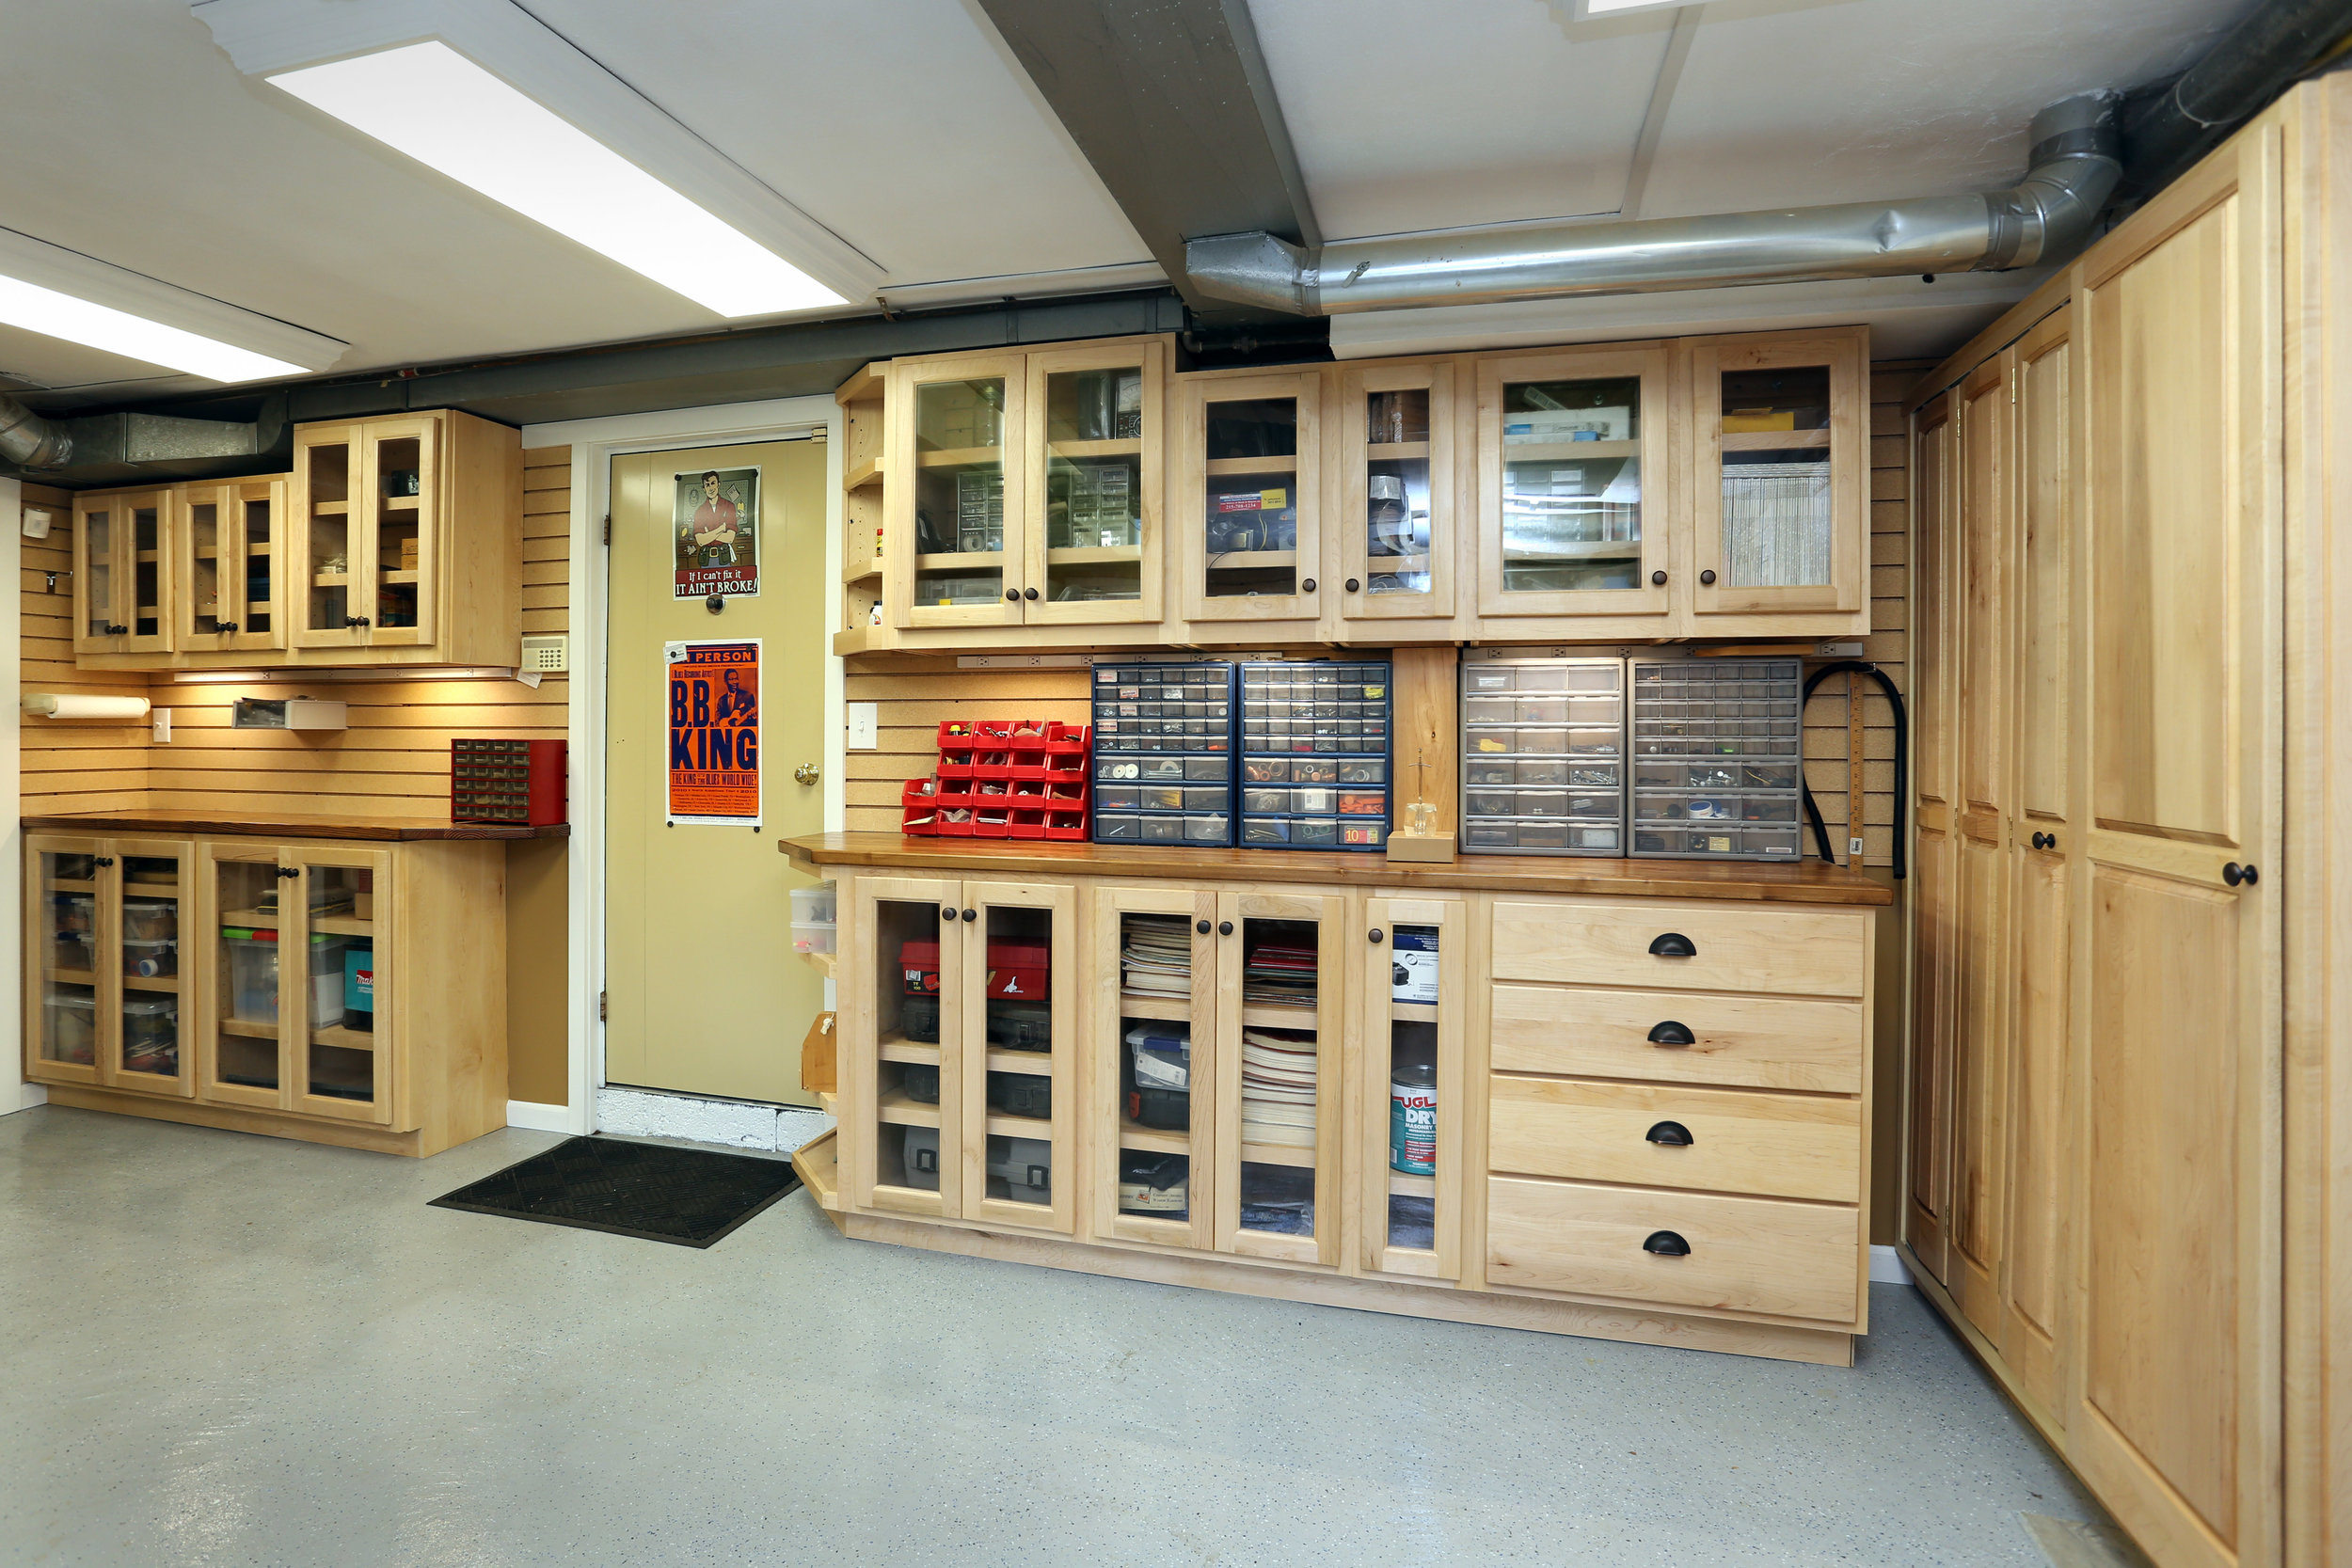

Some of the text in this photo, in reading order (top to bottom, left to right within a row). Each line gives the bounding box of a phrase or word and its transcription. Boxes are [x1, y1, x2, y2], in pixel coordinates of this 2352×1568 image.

[689, 569, 742, 583] If I can't fix it
[676, 578, 758, 595] IT AIN'T BROKE!
[696, 652, 751, 662] PERSON
[671, 679, 715, 728] B.B.
[671, 728, 757, 771] KING
[672, 773, 682, 784] THE
[683, 773, 696, 784] KING
[706, 773, 720, 785] BLUES
[722, 773, 740, 785] WORLD
[741, 774, 757, 786] WIDE!
[1345, 830, 1359, 842] 10
[1402, 1096, 1435, 1108] UGL
[1405, 1122, 1433, 1131] MASONRY
